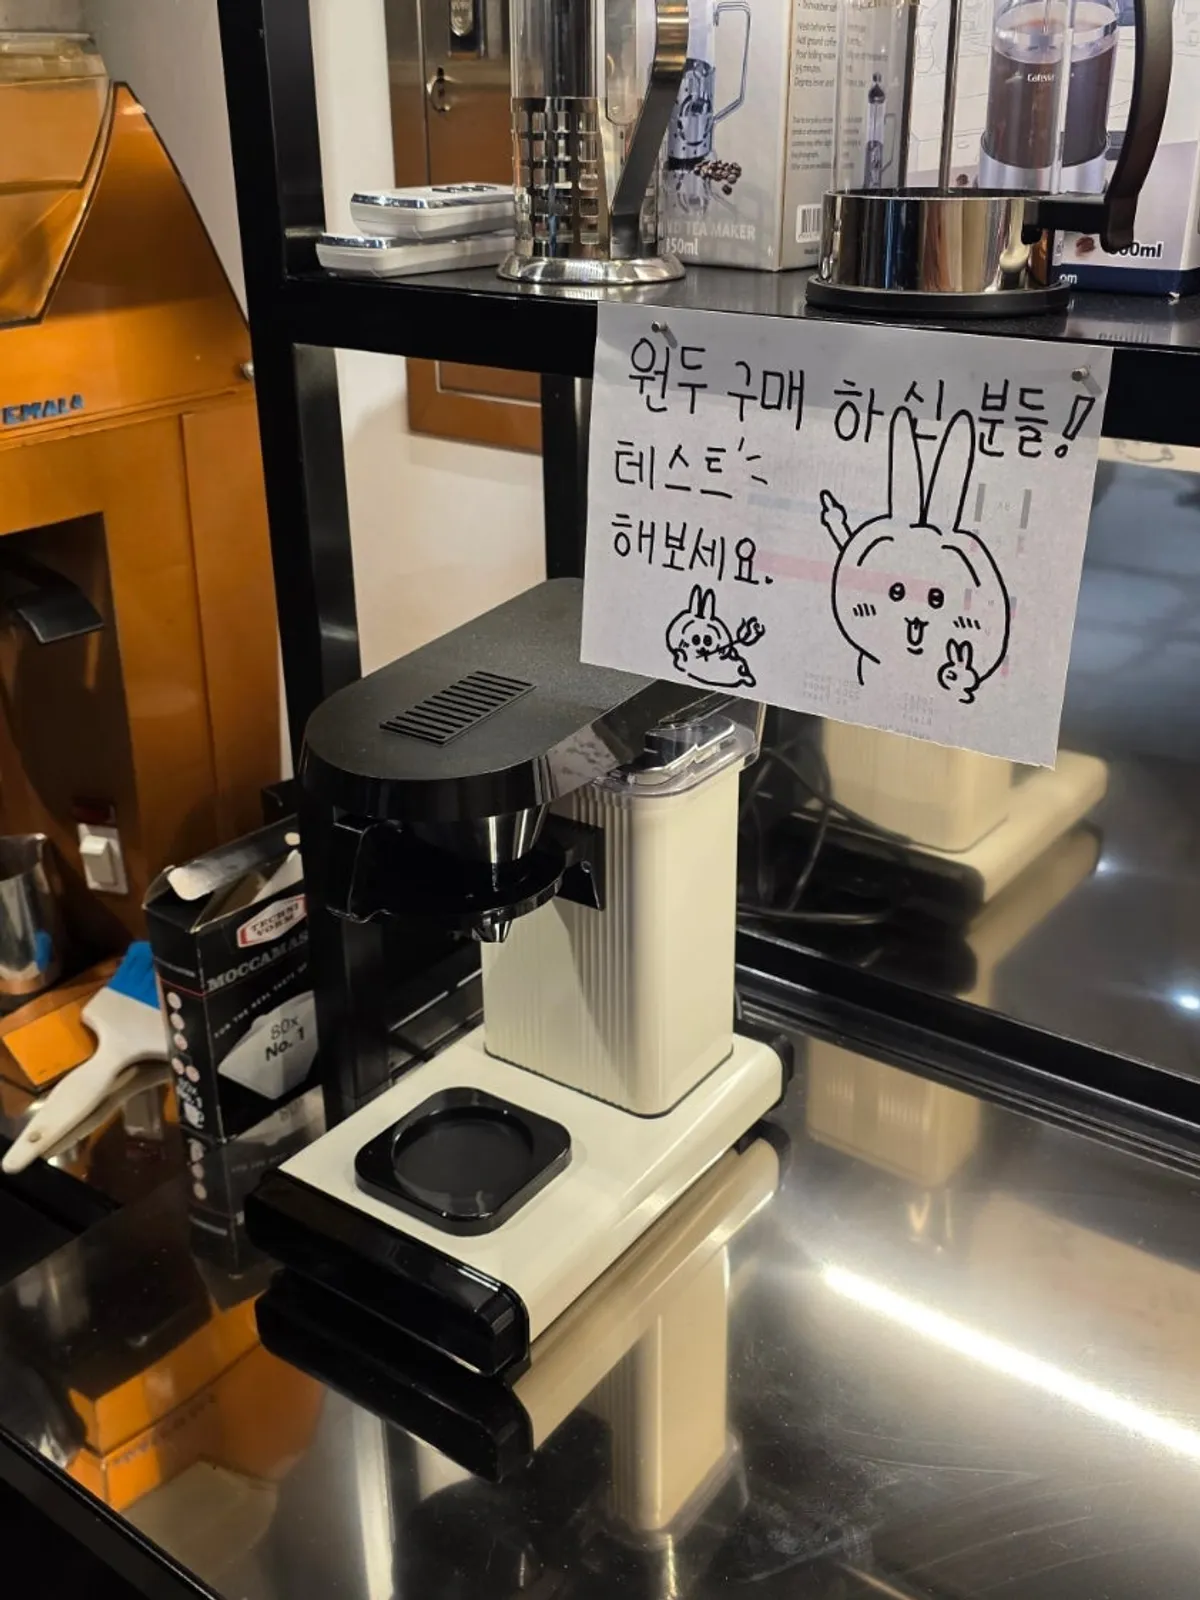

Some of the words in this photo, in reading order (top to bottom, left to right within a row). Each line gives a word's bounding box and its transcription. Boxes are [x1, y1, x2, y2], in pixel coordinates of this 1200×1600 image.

[686, 220, 708, 237] TEA
[711, 223, 756, 240] MAKER
[628, 337, 709, 414] 원두
[726, 360, 805, 431] 구매
[977, 378, 1097, 459] 분들!
[614, 439, 734, 500] 테스트
[611, 513, 774, 585] 해보세요.
[265, 1040, 293, 1062] No.
